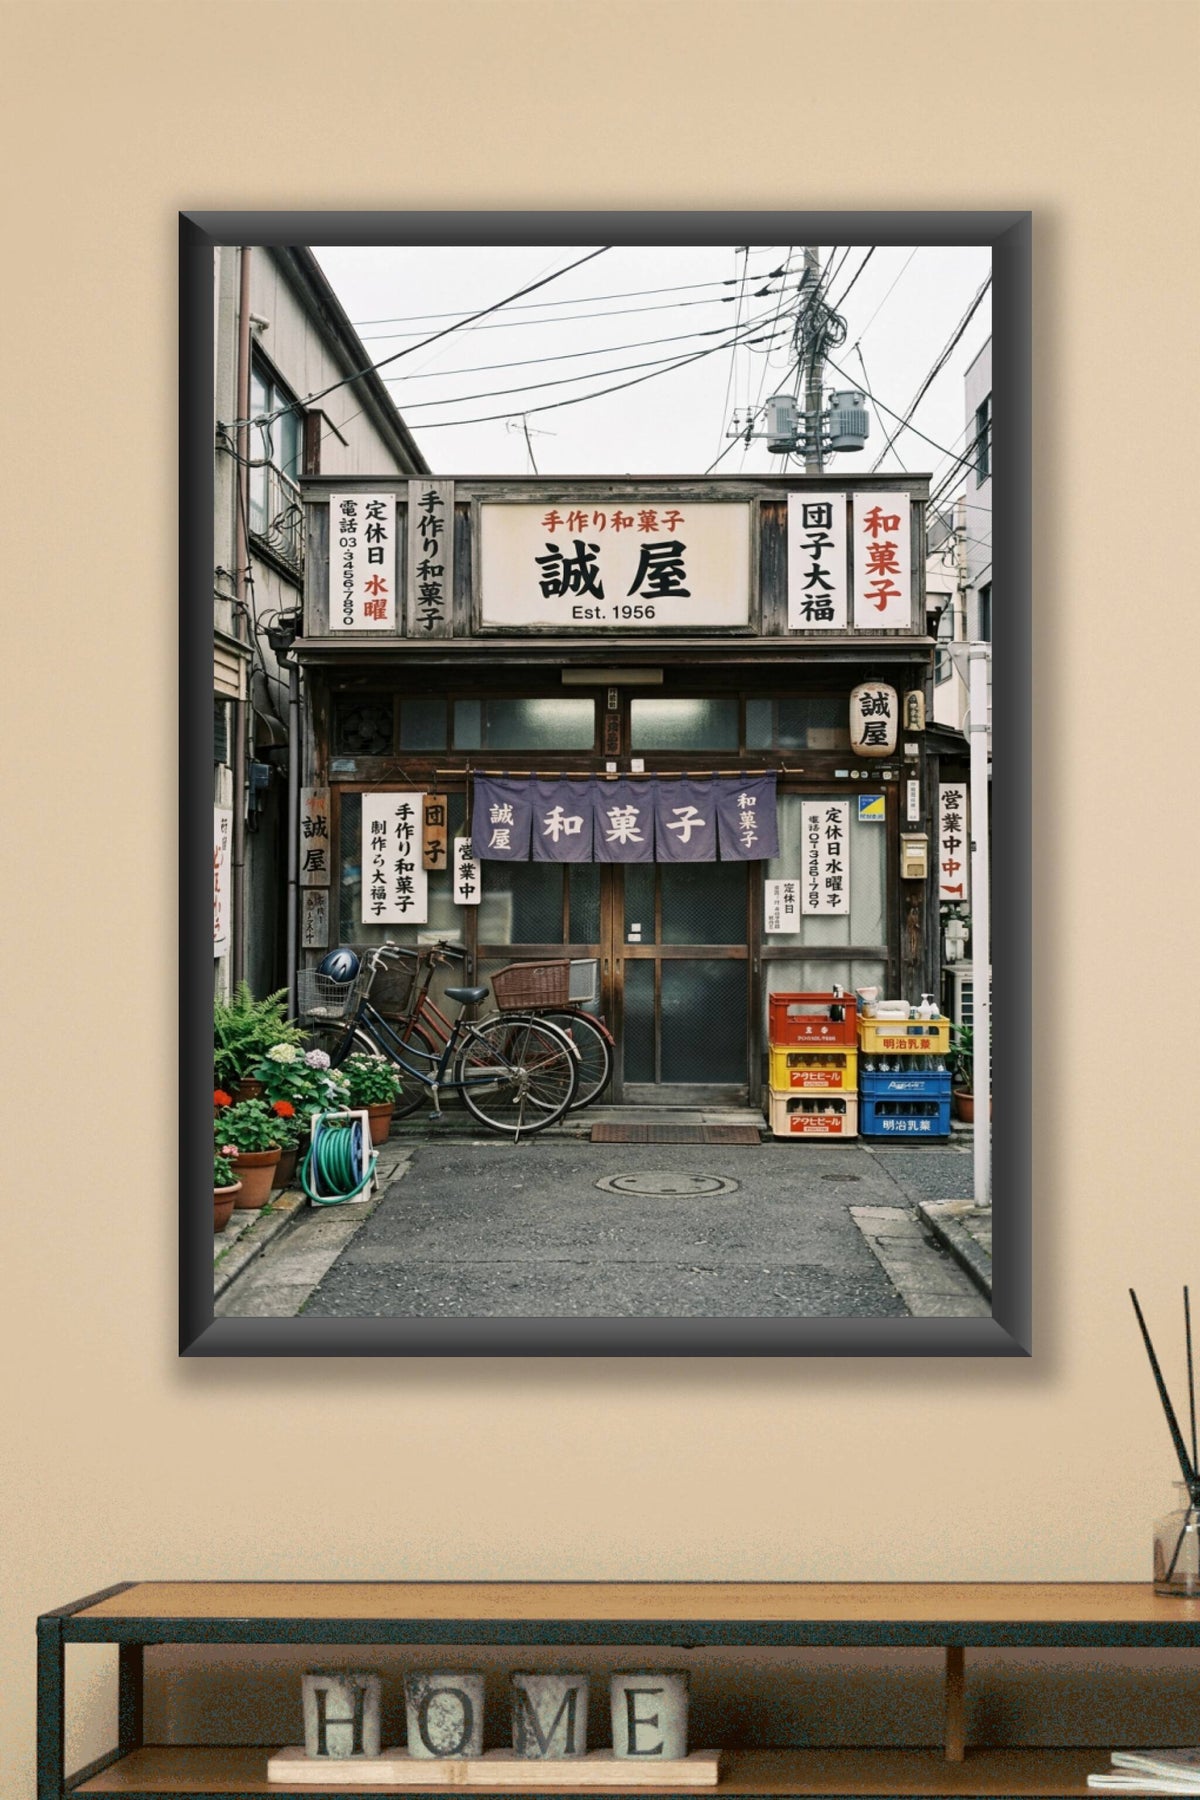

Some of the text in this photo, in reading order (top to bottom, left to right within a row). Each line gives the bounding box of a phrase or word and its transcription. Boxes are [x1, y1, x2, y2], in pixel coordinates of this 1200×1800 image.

[541, 509, 685, 533] 手作り和菓子
[364, 500, 389, 621] 定休日 水曜
[416, 490, 444, 631] 手作り和菓子
[535, 539, 691, 600] 誠屋
[800, 502, 835, 622] 団子大福
[863, 506, 902, 612] 和菓子
[572, 605, 656, 619] Est. 1956
[858, 691, 891, 747] 誠屋
[302, 815, 328, 872] 誠屋
[425, 805, 445, 863] 団子
[488, 803, 514, 850] 誠屋
[543, 805, 706, 845] 和菓子
[737, 792, 759, 848] 和菓子
[395, 803, 415, 913] 手作り和菓子
[459, 843, 477, 900] 営業中
[315, 1687, 665, 1757] HOME
